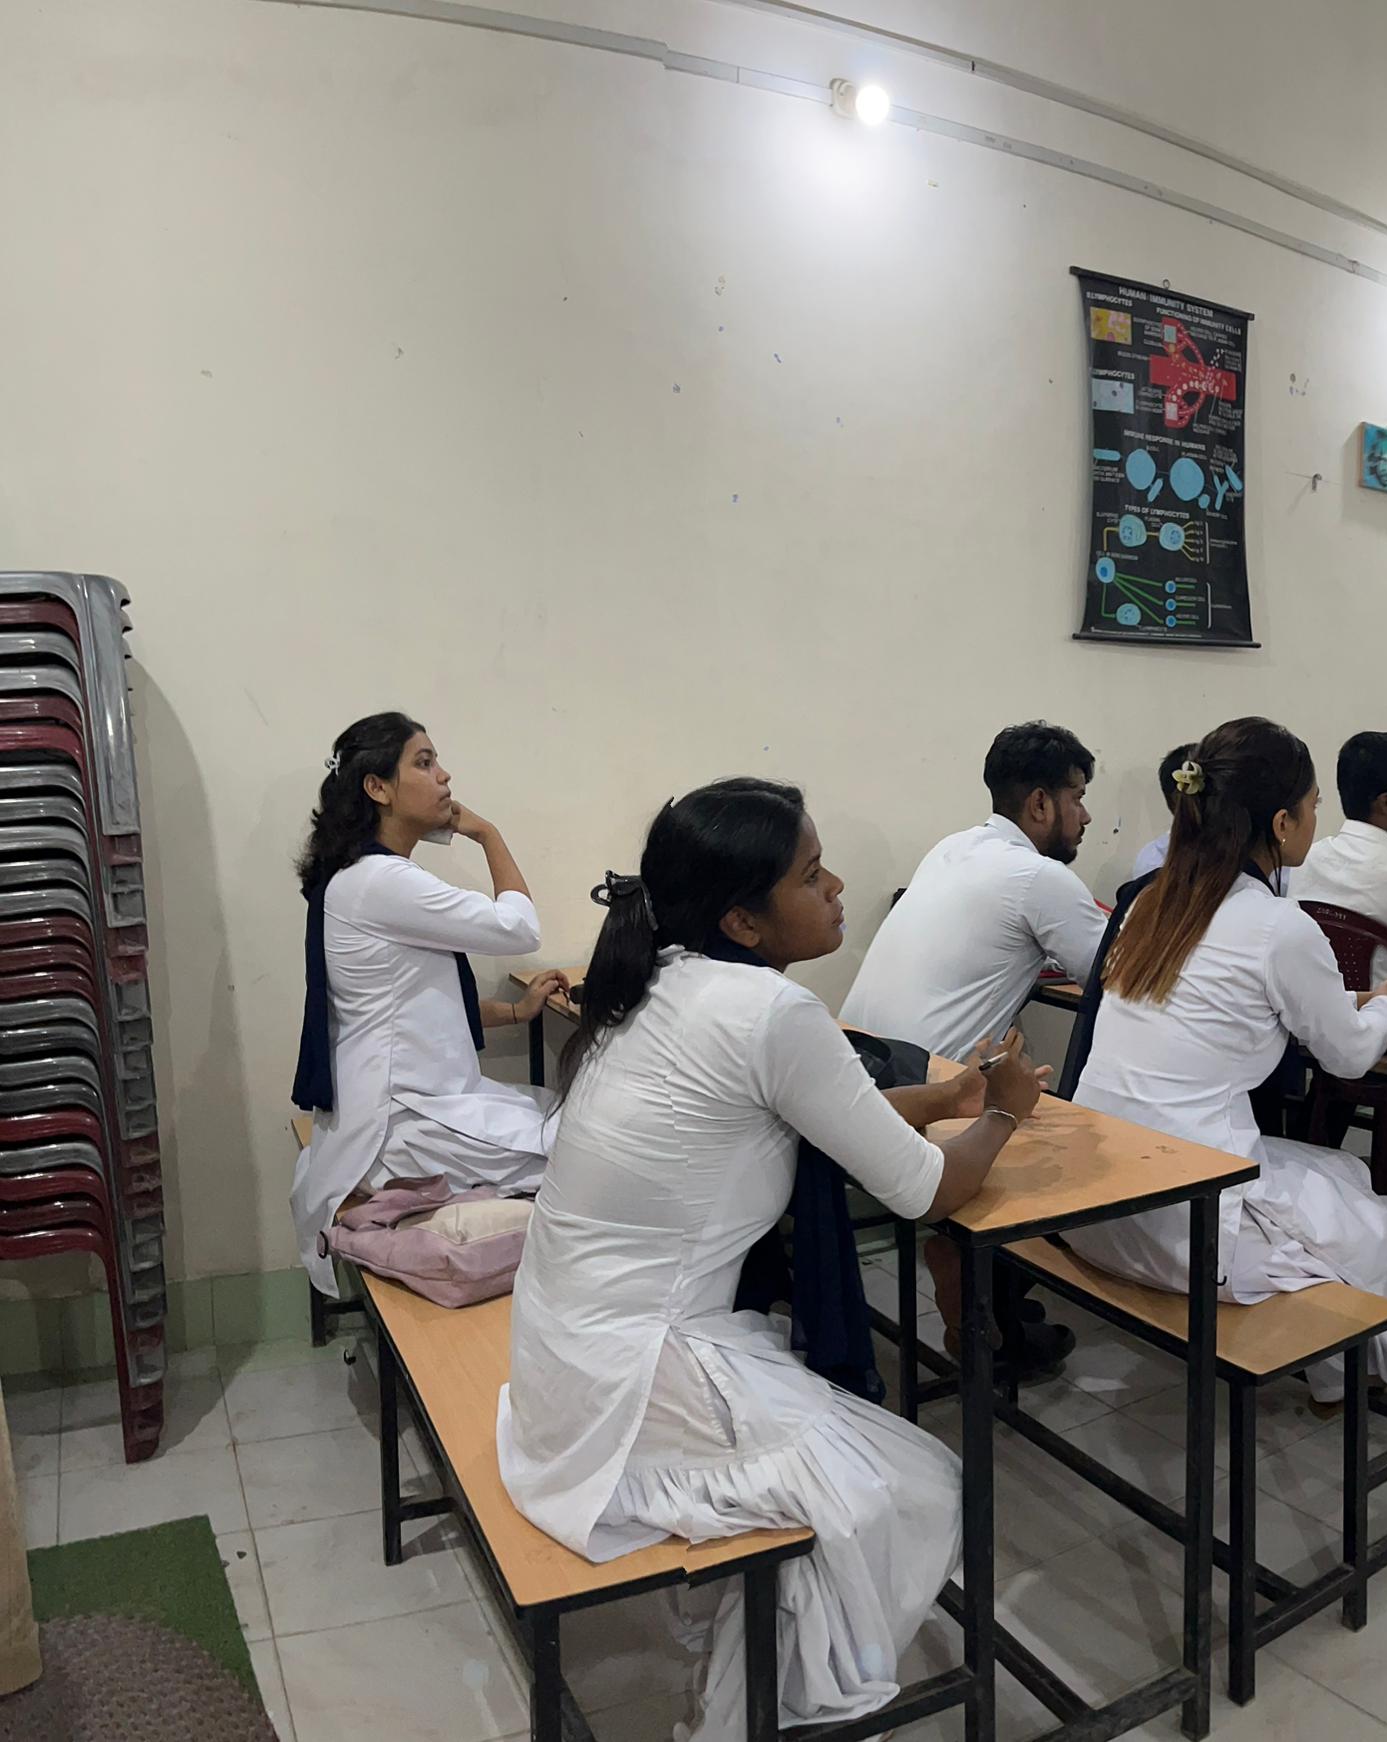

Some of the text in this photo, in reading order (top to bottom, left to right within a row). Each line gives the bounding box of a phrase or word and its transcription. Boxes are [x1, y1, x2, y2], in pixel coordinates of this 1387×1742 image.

[1118, 286, 1214, 317] HUMAN IMMUNITY SYSTEM
